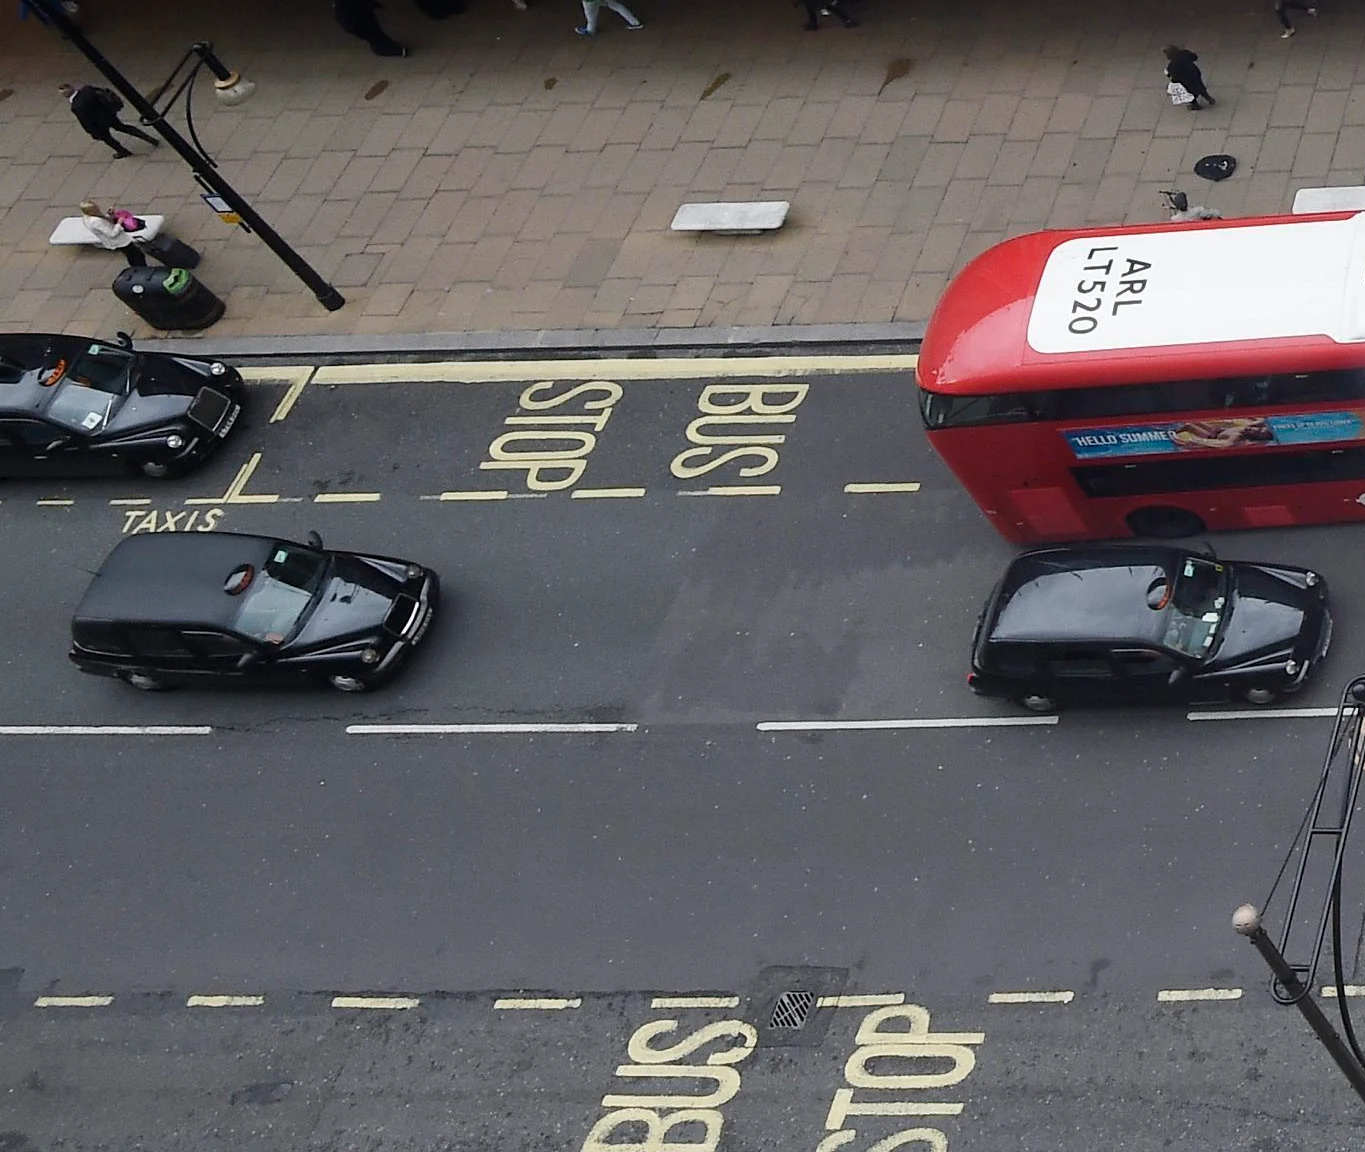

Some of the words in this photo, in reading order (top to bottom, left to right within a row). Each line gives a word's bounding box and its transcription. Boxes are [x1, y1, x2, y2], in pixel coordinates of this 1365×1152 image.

[1068, 246, 1119, 334] LT520
[1112, 258, 1152, 316] ARL
[479, 381, 624, 491] STOP
[670, 383, 810, 479] BUS
[122, 508, 225, 534] TAXIS
[580, 1019, 758, 1152] BUS
